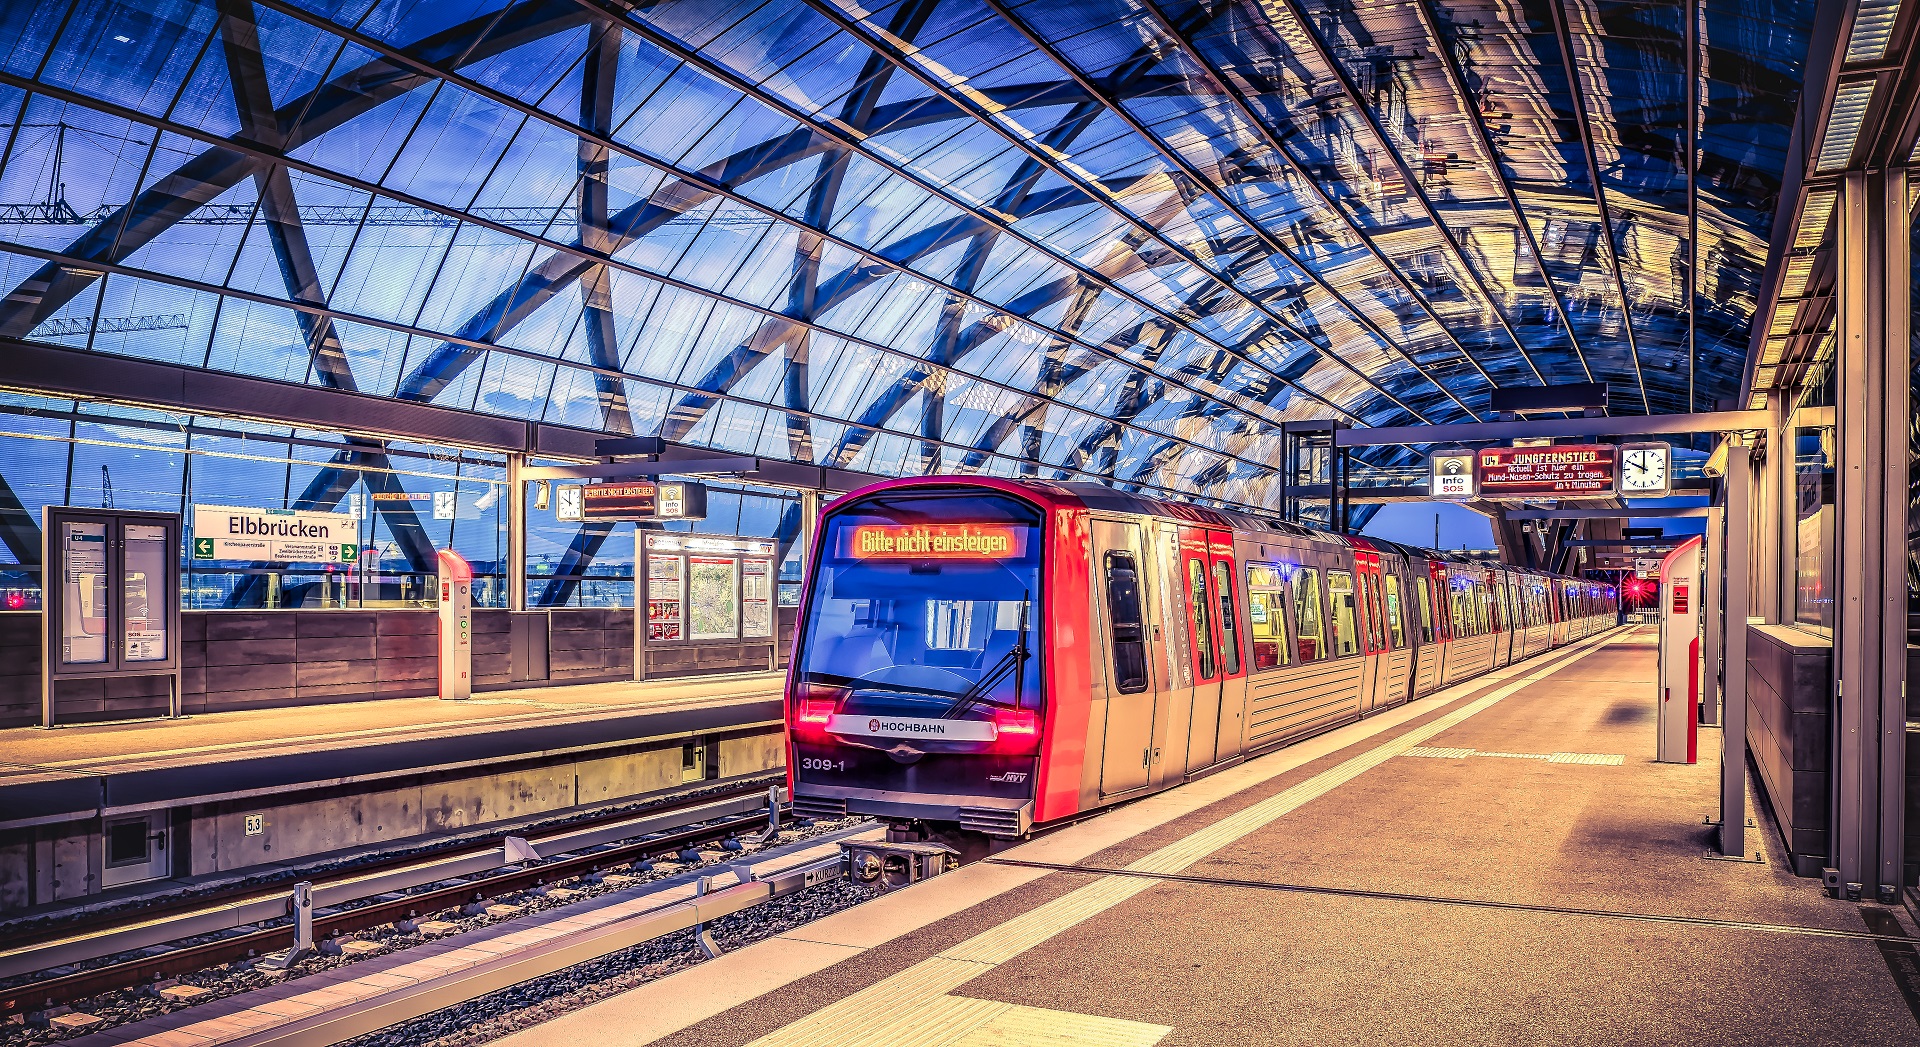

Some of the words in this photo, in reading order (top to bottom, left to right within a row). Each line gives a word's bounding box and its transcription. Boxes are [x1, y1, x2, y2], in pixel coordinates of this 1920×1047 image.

[1512, 452, 1596, 464] JUNGFERNSTIEG
[1508, 465, 1532, 473] Aktuell
[1536, 464, 1547, 472] ist
[1442, 477, 1464, 485] Info
[1488, 472, 1560, 482] Mund-Nasen-Schutz
[1555, 482, 1564, 490] in
[1565, 482, 1570, 490] 4
[1571, 481, 1600, 489] Minuten
[229, 516, 329, 538] Elbbrücken
[862, 530, 894, 552] Bitte
[896, 529, 931, 552] nicht
[933, 529, 1007, 555] einsteigen
[881, 722, 945, 734] HOCHBAHN
[802, 757, 845, 772] 309-1
[248, 818, 260, 832] 5.3
[815, 864, 840, 882] KURZZU
